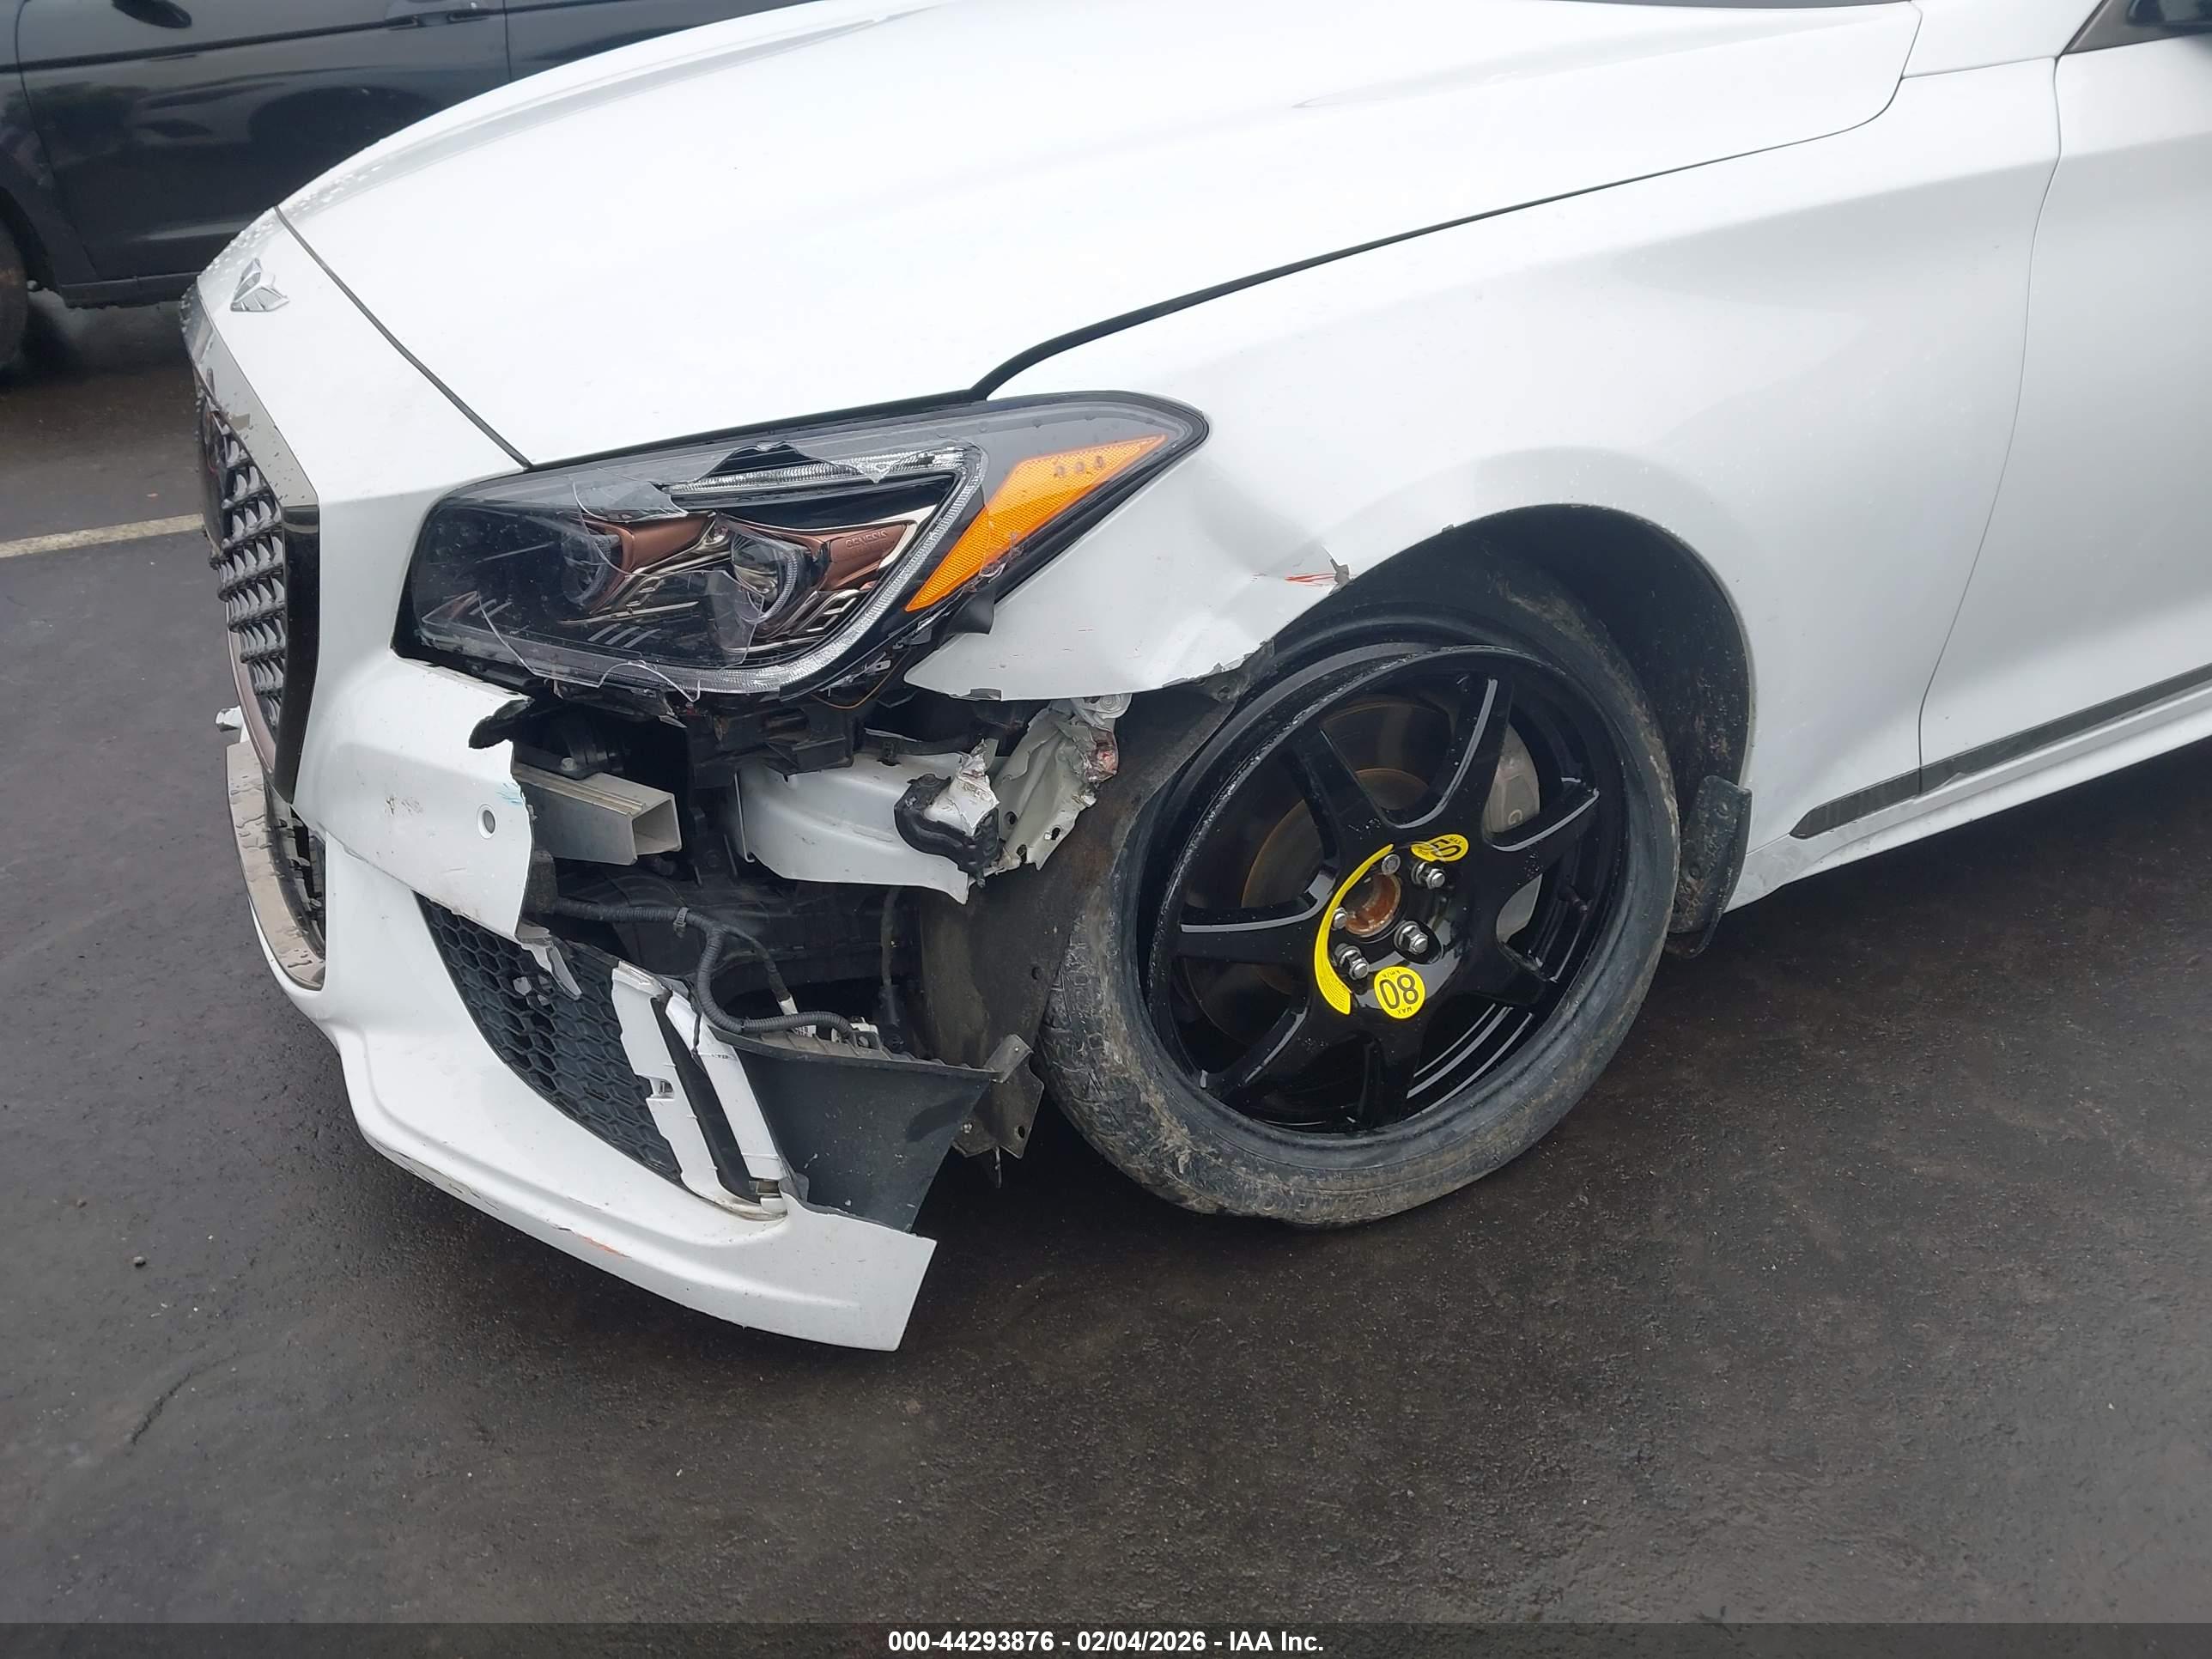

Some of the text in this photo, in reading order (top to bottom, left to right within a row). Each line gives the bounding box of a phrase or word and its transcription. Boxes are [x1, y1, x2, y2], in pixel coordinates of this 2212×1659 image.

[845, 530, 887, 550] GENESIS
[1379, 974, 1419, 1010] 80
[1396, 1006, 1413, 1016] MAX
